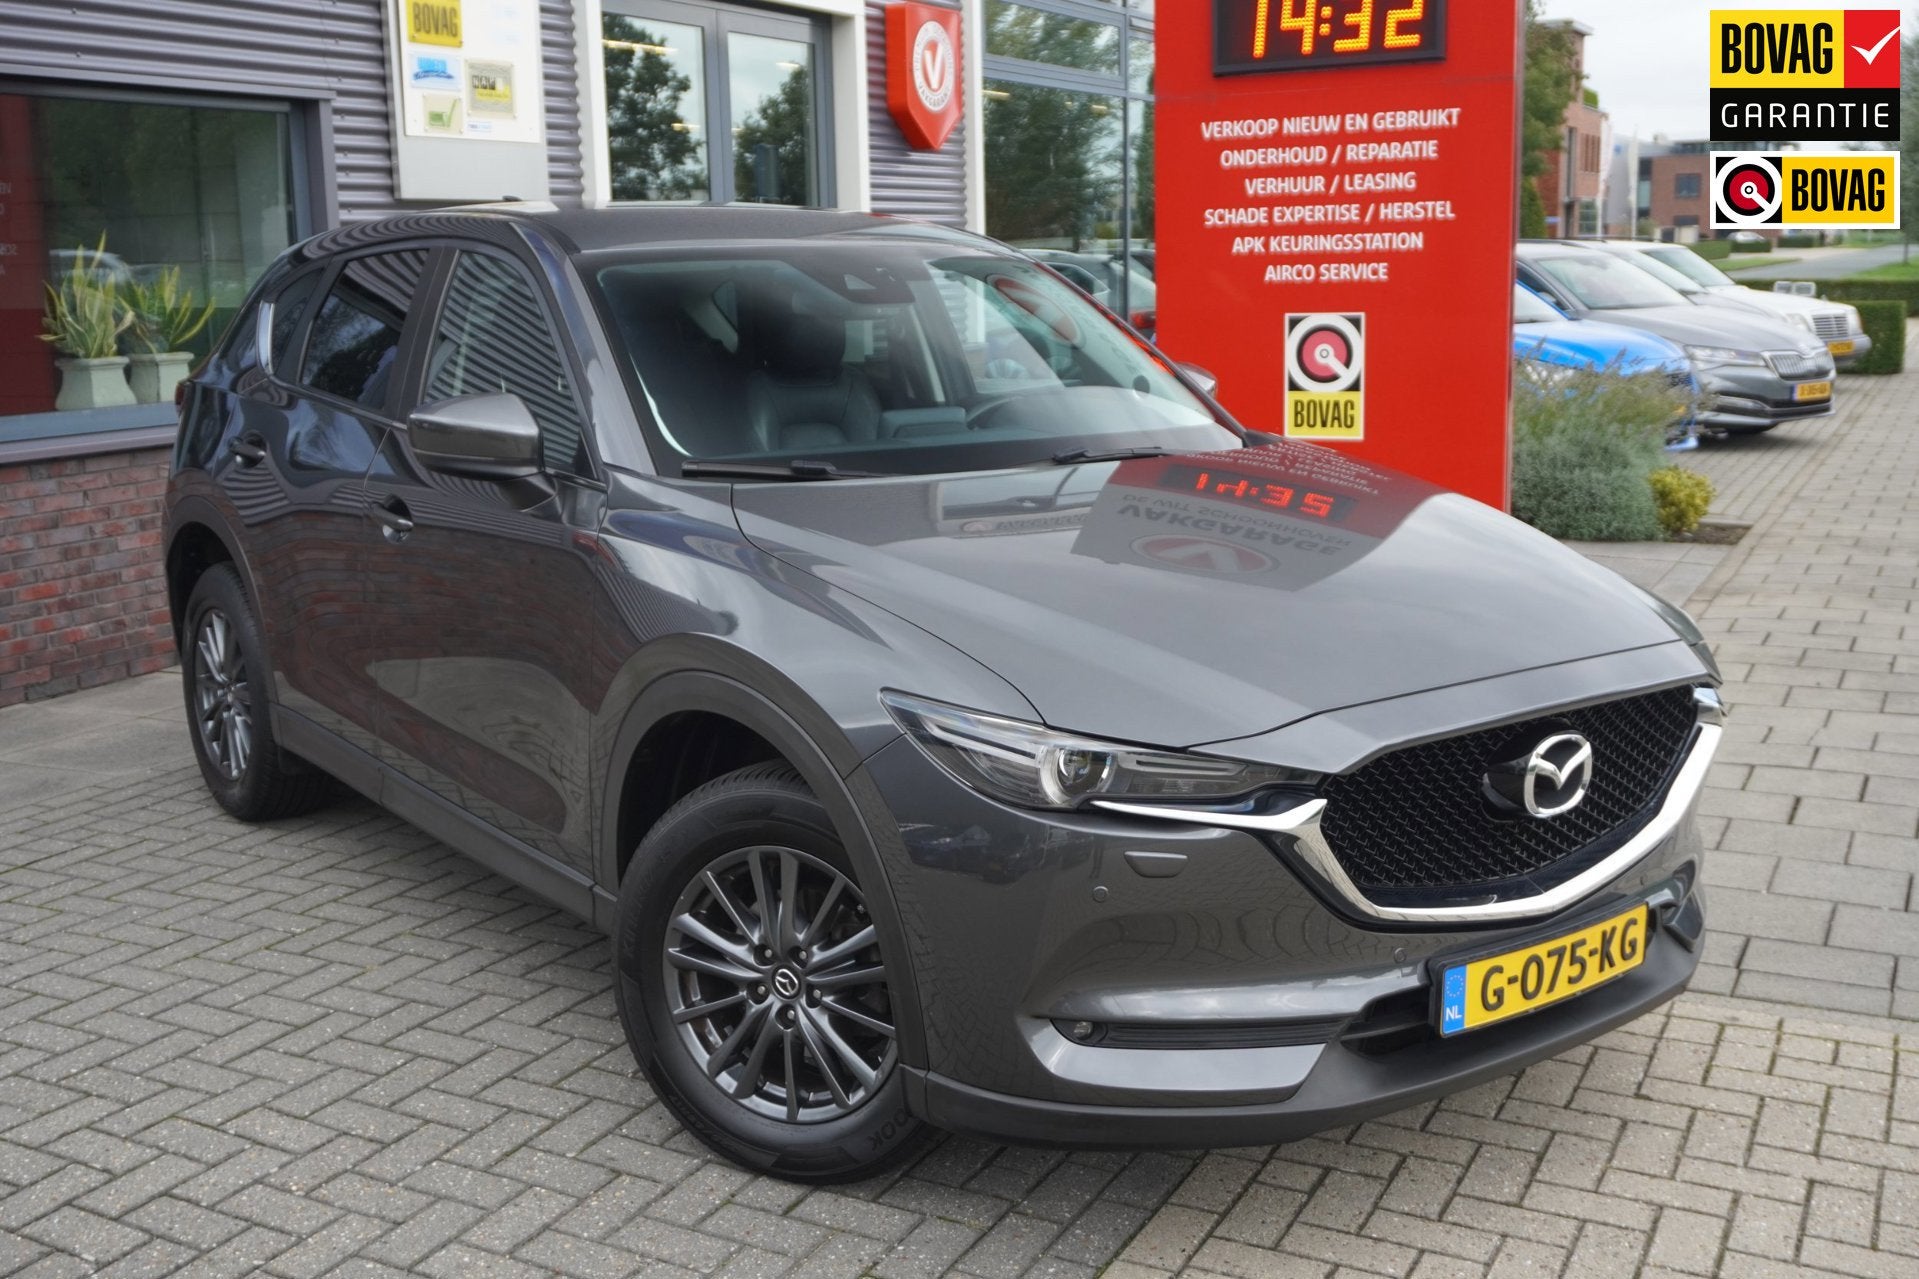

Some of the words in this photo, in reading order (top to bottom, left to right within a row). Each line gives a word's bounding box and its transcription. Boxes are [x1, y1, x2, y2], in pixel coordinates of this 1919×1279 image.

[412, 2, 459, 38] BOVAG
[1253, 0, 1424, 58] 14:32
[1201, 117, 1279, 140] VERKOOP
[1282, 114, 1342, 135] NIEUW
[1344, 112, 1369, 133] EN
[1372, 107, 1461, 131] GEBRUIKT
[1220, 145, 1328, 168] ONDERHOUD
[1331, 144, 1342, 165] /
[1345, 139, 1438, 162] REPARATIE
[1244, 175, 1326, 196] VERHUUR
[1329, 174, 1340, 194] /
[1343, 171, 1417, 193] LEASING
[1204, 206, 1269, 226] SCHADE
[1272, 203, 1361, 224] EXPERTISE
[1364, 203, 1375, 223] /
[1379, 200, 1456, 221] HERSTEL
[1231, 236, 1266, 254] APK
[1269, 231, 1424, 253] KEURINGSSTATION
[1264, 263, 1316, 282] AIRCO
[1319, 262, 1389, 282] SERVICE
[1294, 399, 1355, 429] BOVAG
[1481, 917, 1638, 1011] G-075-KG
[1446, 1006, 1462, 1021] NL
